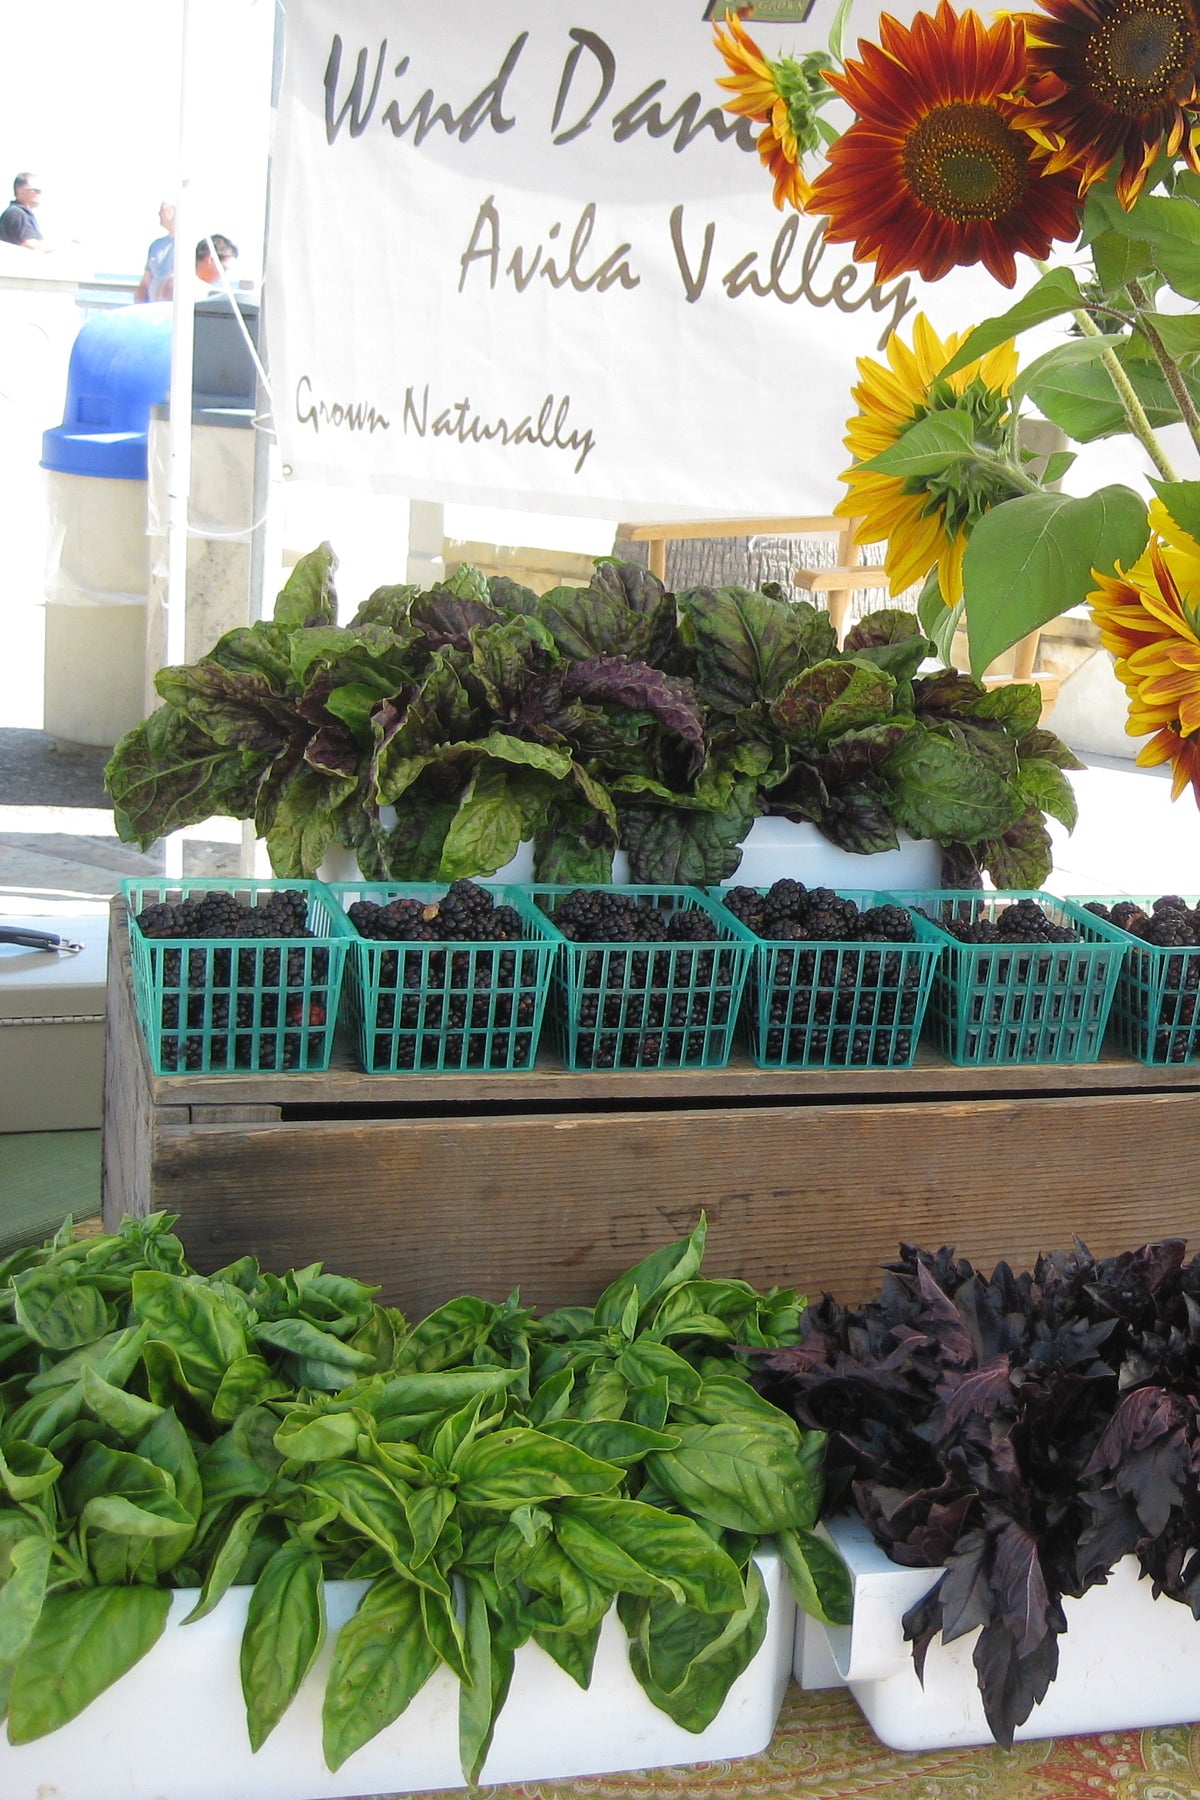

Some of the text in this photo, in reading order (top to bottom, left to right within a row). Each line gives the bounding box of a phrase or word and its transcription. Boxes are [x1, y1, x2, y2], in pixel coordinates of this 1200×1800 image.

[323, 27, 757, 154] Wind Danc
[458, 195, 917, 351] Avila Valley
[296, 375, 596, 473] Grown Naturally
